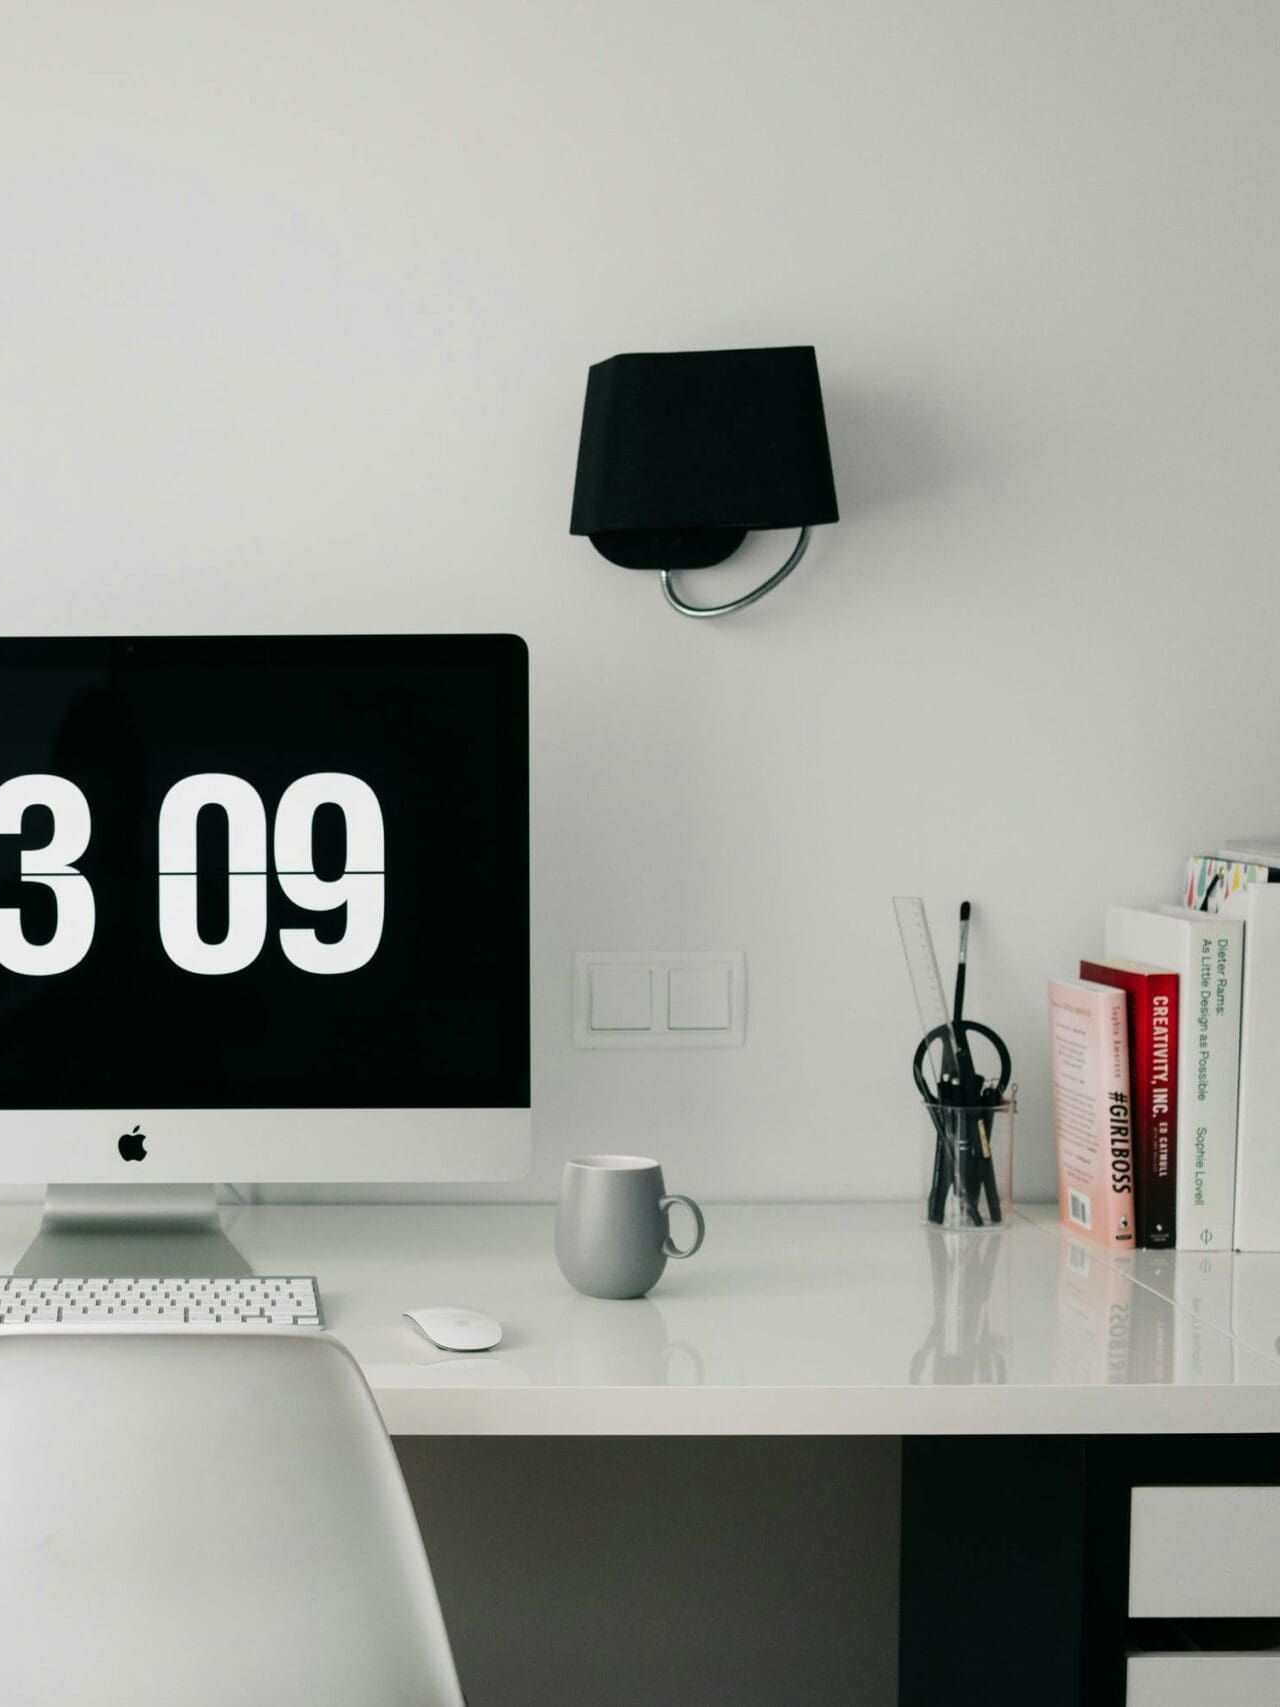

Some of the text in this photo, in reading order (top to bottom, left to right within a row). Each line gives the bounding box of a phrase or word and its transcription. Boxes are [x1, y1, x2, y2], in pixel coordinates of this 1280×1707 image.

[158, 772, 385, 975] 09
[1217, 938, 1228, 975] Dieter
[1151, 996, 1169, 1118] CREATIVITY, INC.
[1198, 938, 1212, 1101] As Little Design as Possible
[1108, 1091, 1131, 1194] #GIRLBOSS
[1158, 1122, 1169, 1177] ED CATMULL
[1194, 1127, 1206, 1206] Sophie Lovell
